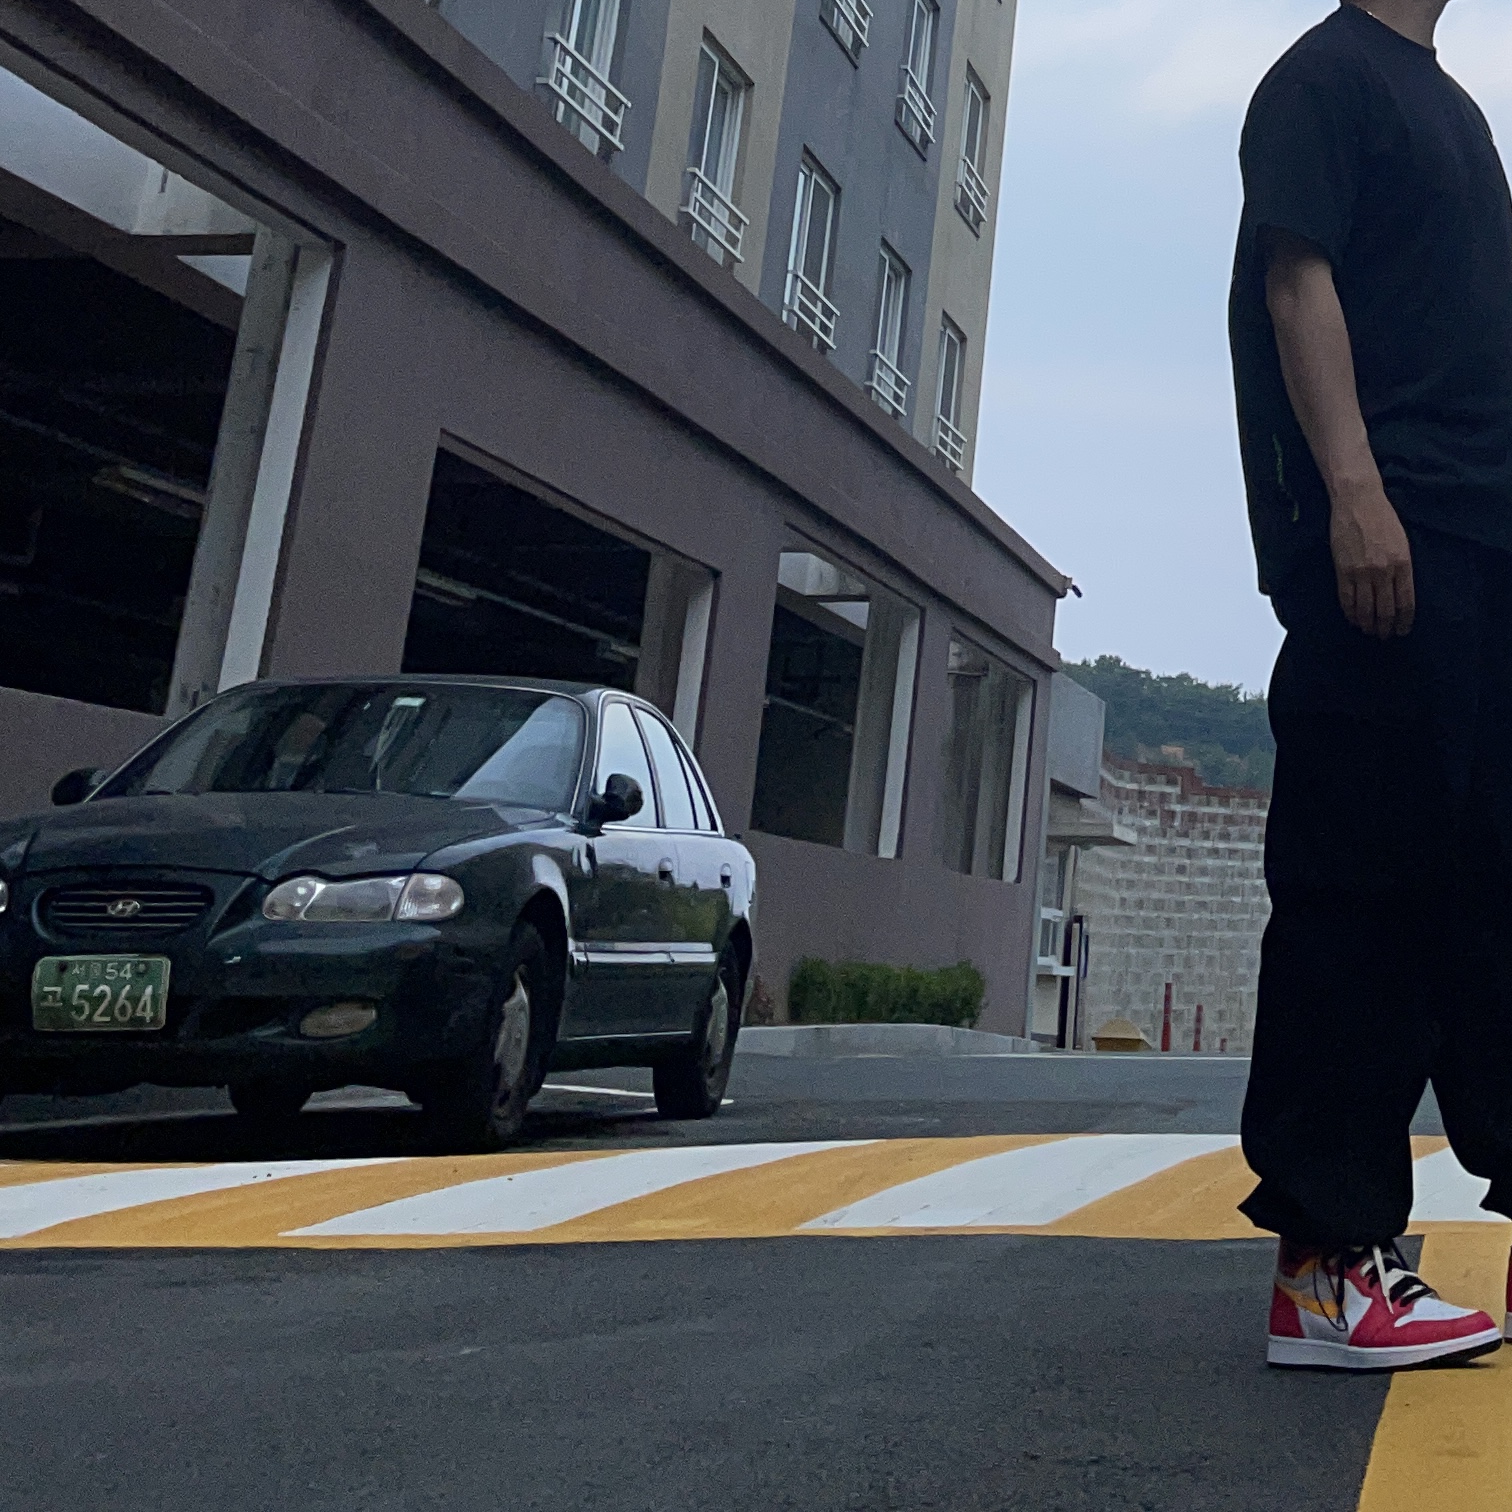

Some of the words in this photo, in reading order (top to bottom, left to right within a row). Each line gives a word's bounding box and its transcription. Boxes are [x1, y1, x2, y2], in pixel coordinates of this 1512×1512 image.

[104, 962, 133, 981] 54
[40, 986, 63, 1008] 고
[70, 984, 154, 1024] 5264
